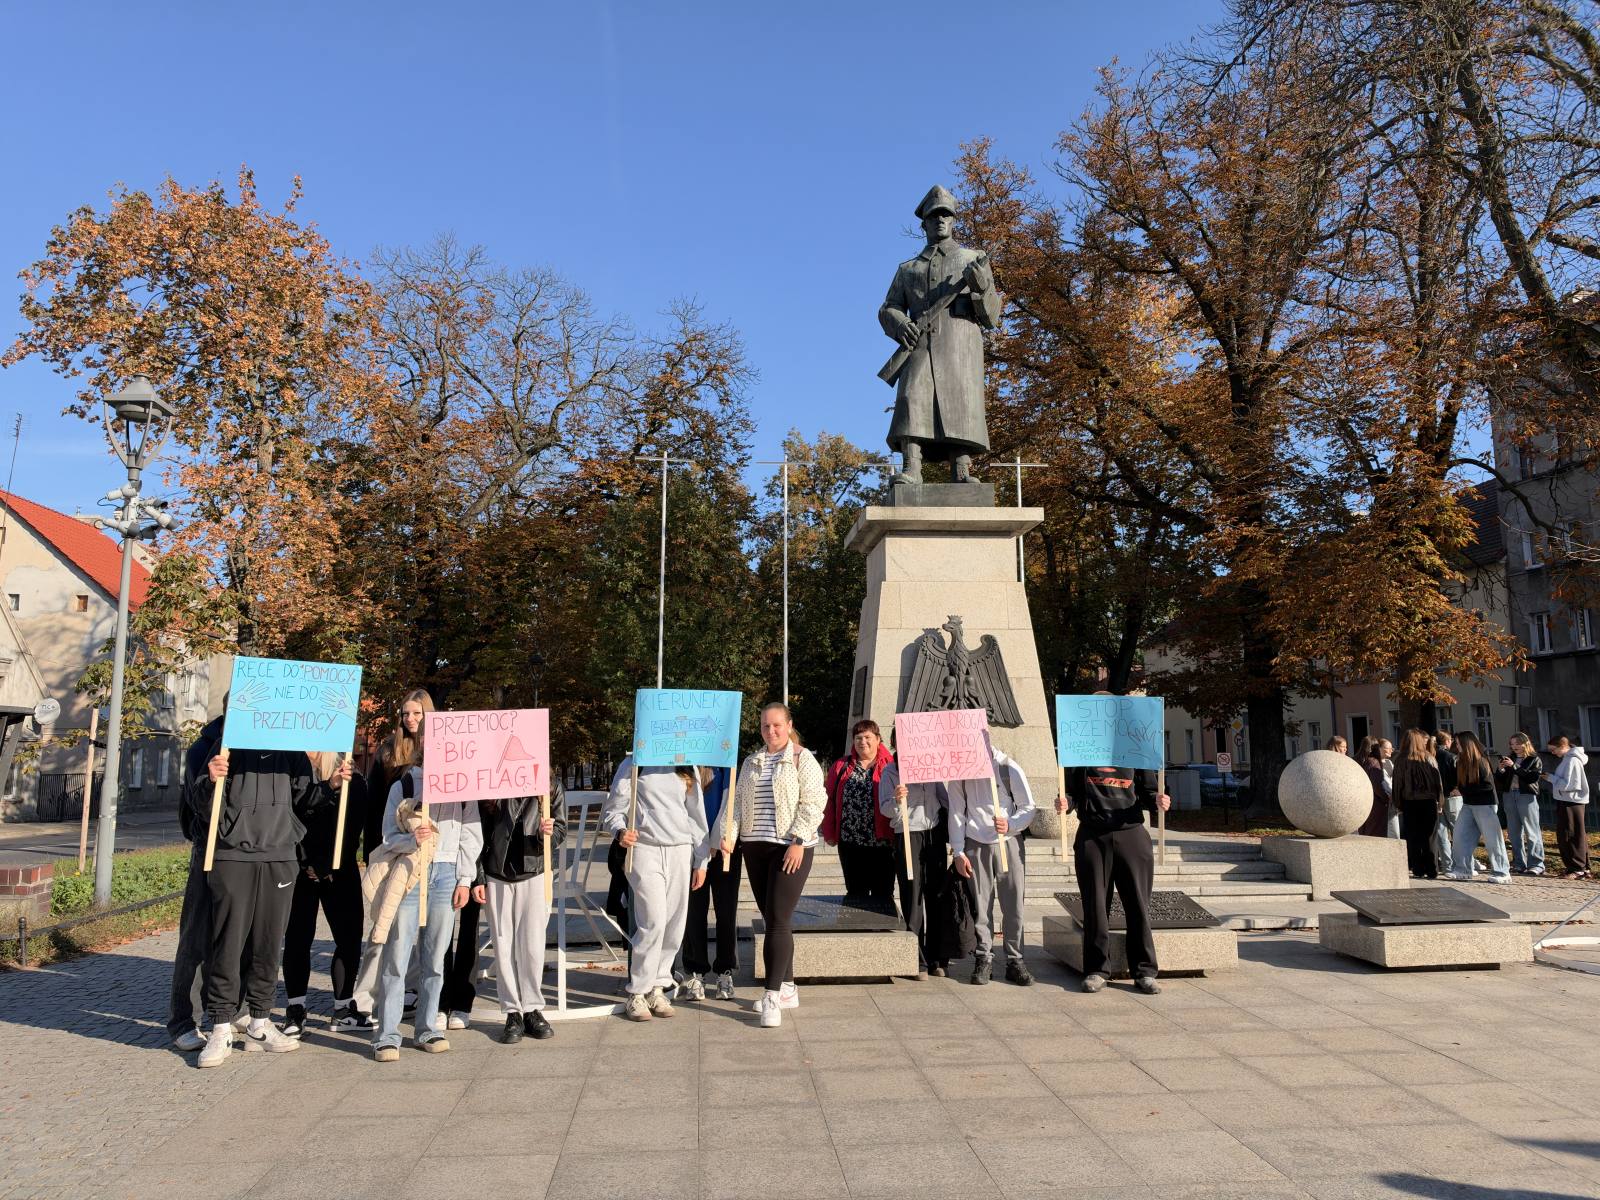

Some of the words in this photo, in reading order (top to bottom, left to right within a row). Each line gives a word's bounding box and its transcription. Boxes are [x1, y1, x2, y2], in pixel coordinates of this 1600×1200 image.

[283, 663, 299, 678] DO
[274, 685, 296, 700] NIE
[300, 685, 319, 700] DO
[1078, 698, 1134, 719] STOP
[253, 711, 338, 733] PRZEMOCY
[432, 710, 518, 738] PRZEMOC?
[900, 713, 945, 736] NASZA
[948, 712, 985, 730] DROGA
[1060, 719, 1154, 737] PRZEMOCY
[444, 740, 478, 763] BIG
[908, 733, 959, 751] PROWADZI
[961, 733, 976, 748] DO
[901, 752, 946, 768] SZKOŁY
[428, 772, 469, 794] RED
[477, 763, 540, 792] FLAG!
[906, 765, 961, 782] PRZEMOCY
